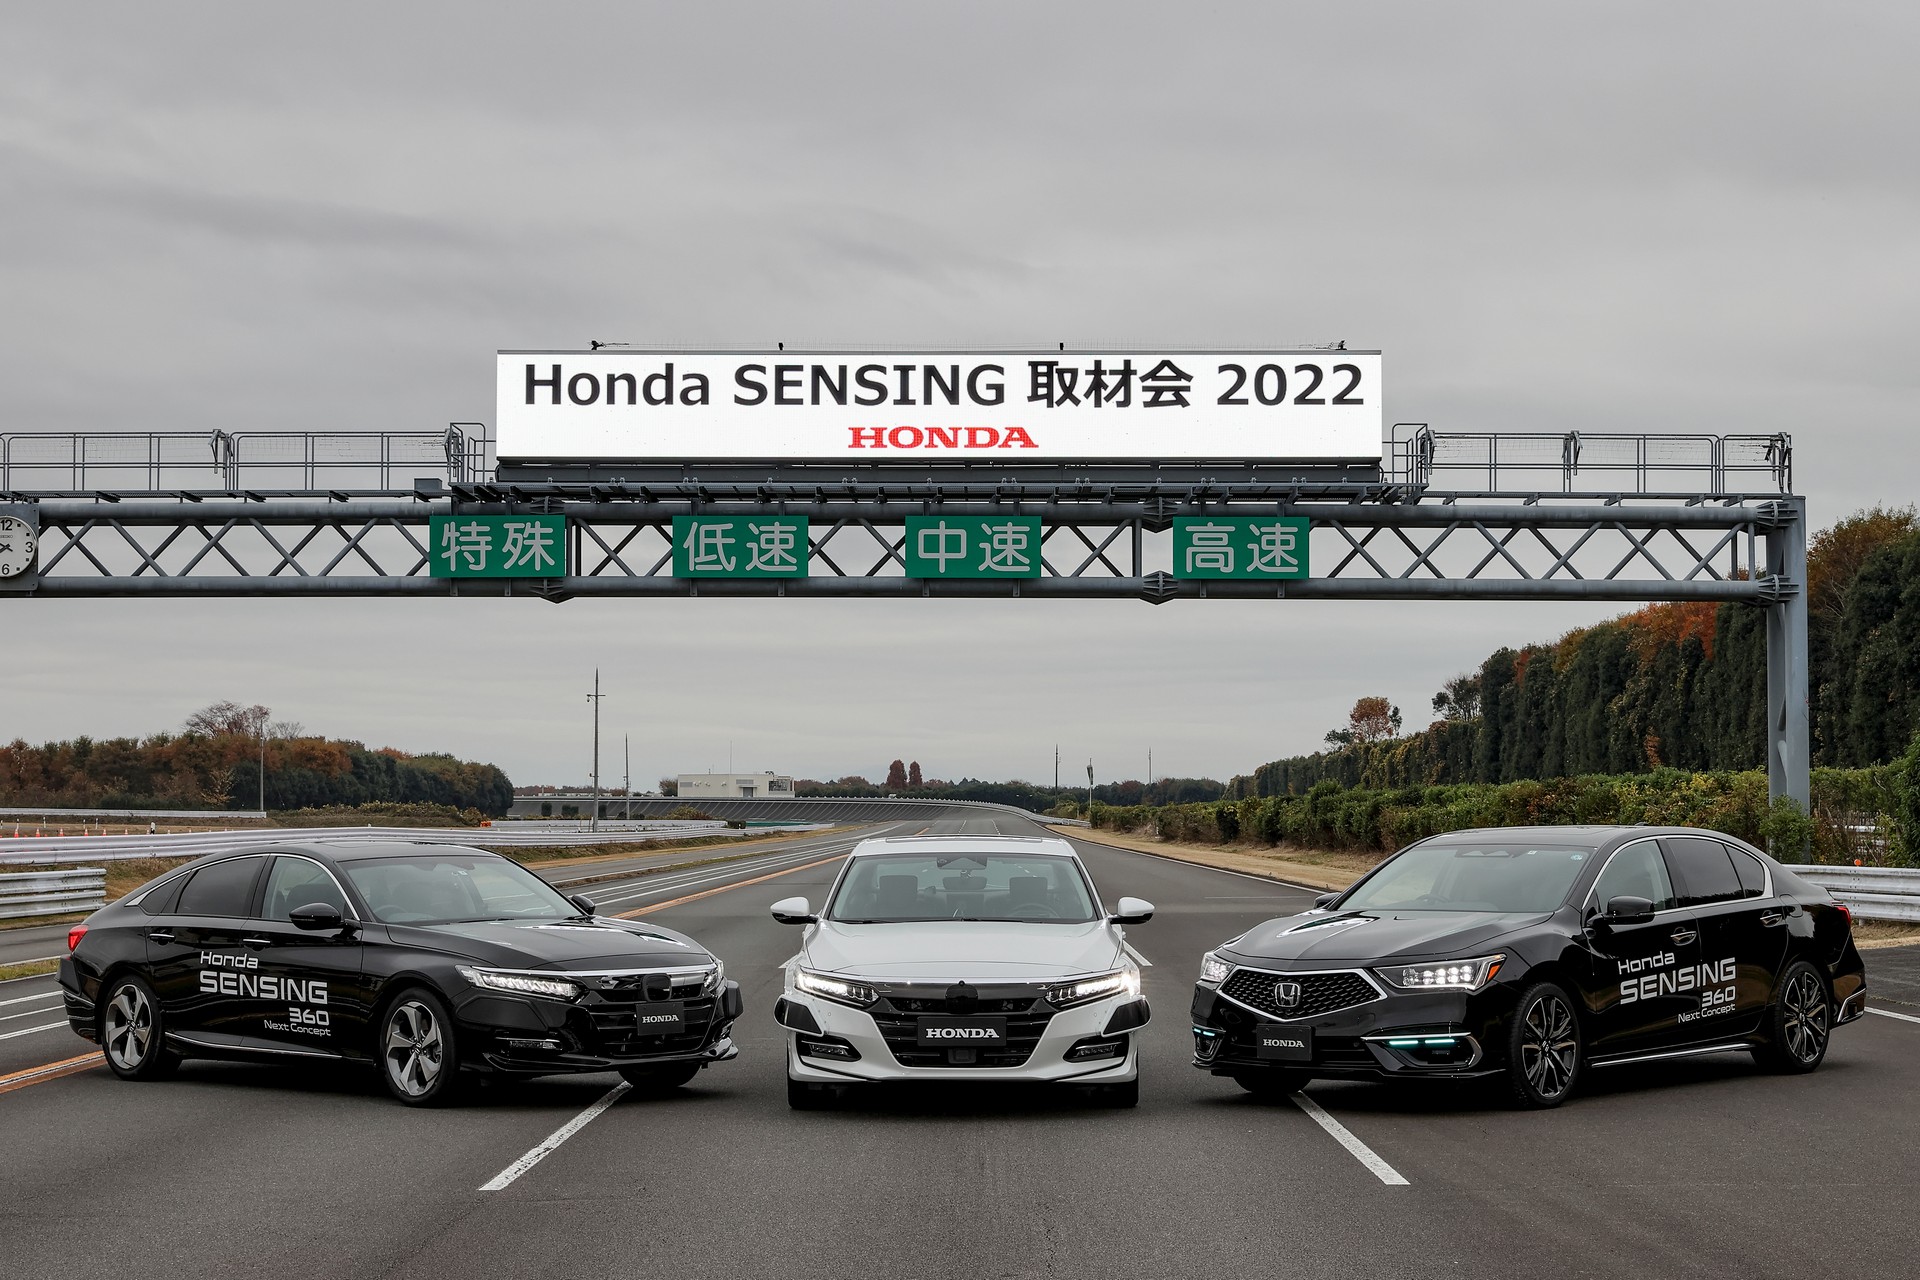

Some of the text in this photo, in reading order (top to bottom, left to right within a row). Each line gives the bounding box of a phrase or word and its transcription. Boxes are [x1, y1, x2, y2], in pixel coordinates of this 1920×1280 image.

[526, 360, 1364, 408] Honda SENSING 取材会 2022
[848, 426, 1038, 448] HONDA
[0, 519, 13, 531] 12
[25, 541, 34, 554] 3
[441, 521, 555, 571] 特殊
[683, 521, 797, 572] 低速
[917, 521, 1031, 573] 中速
[1185, 522, 1299, 573] 高速
[1, 563, 10, 575] 6
[201, 951, 259, 969] Honda
[1618, 951, 1675, 975] Honda
[200, 971, 328, 1004] SENSING
[1620, 957, 1736, 1005] SENSING
[1701, 985, 1736, 1008] 360
[289, 1007, 330, 1026] 360
[642, 1014, 680, 1024] HONDA
[1678, 1003, 1736, 1024] Next Concept
[264, 1020, 331, 1037] Next Concept
[925, 1028, 1000, 1039] HONDA
[1263, 1038, 1305, 1048] HONDA
